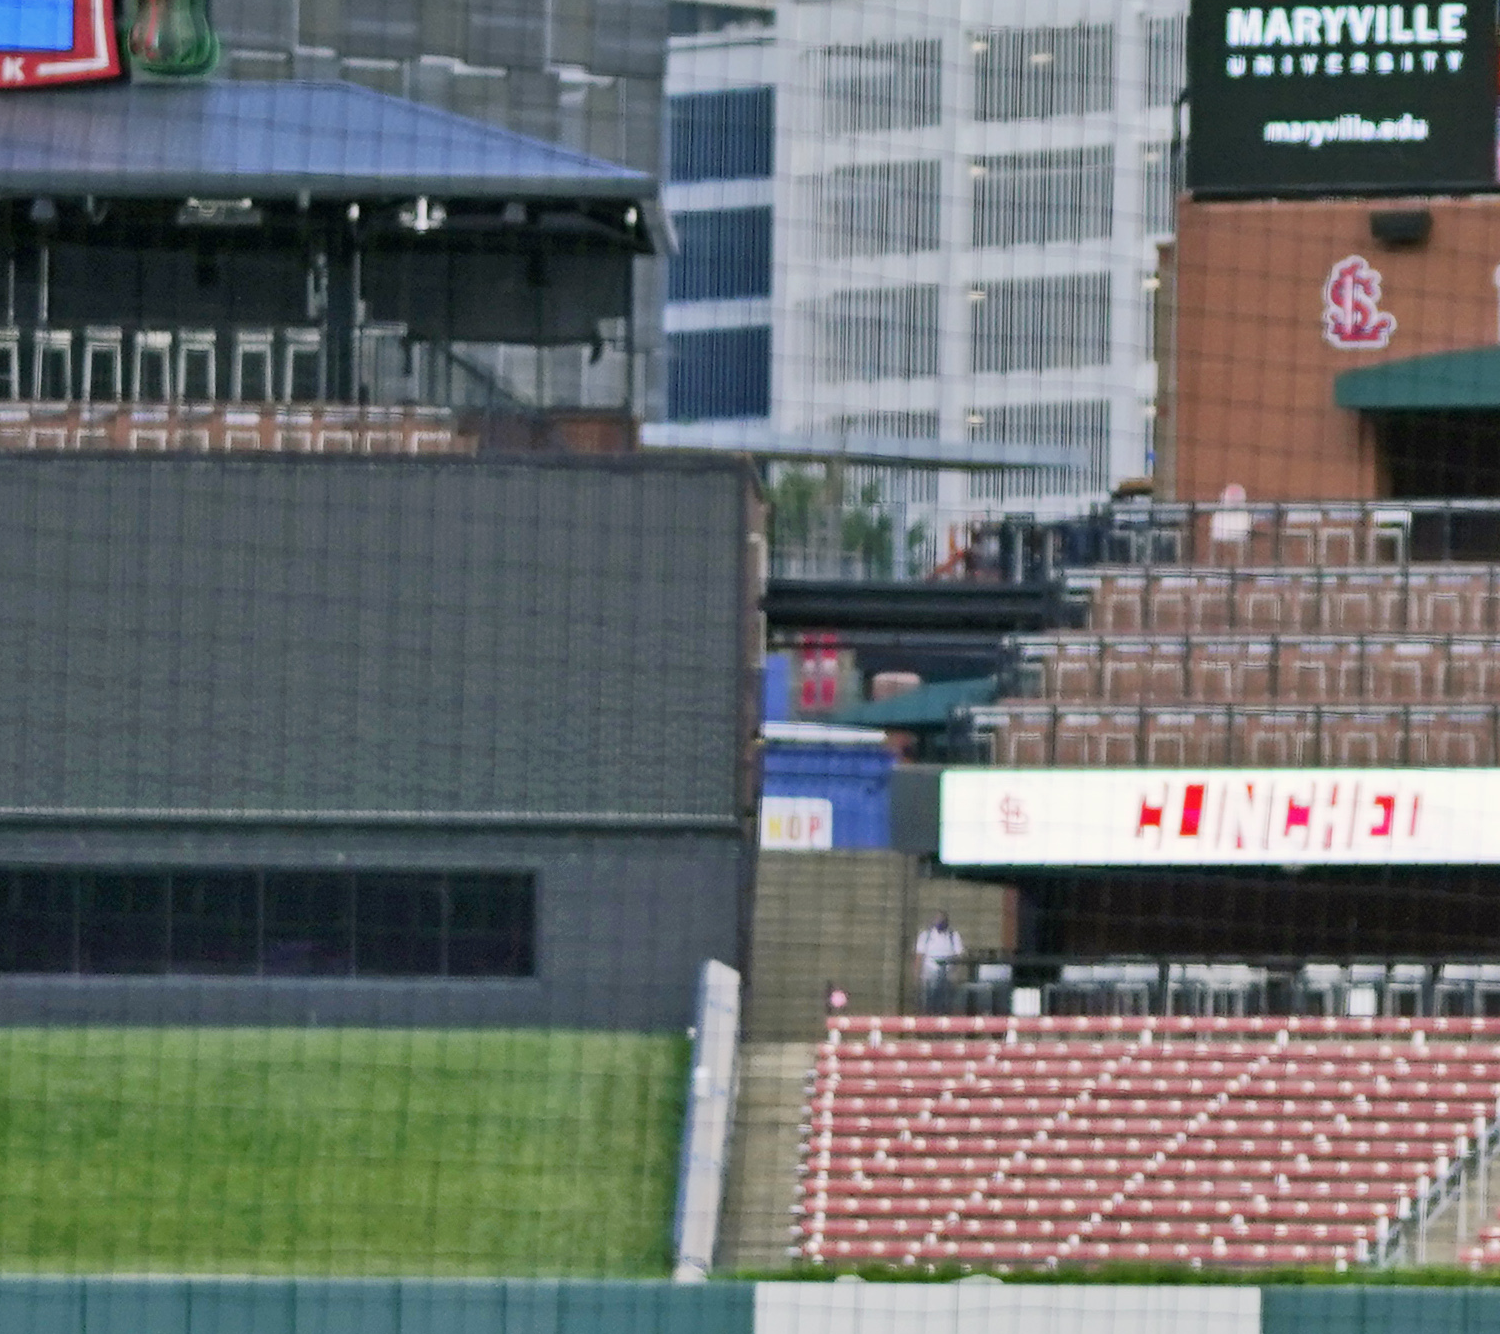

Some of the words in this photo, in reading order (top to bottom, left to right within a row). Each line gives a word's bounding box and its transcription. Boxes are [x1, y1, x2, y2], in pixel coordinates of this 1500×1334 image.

[1226, 3, 1466, 47] MARYVILLE
[1226, 50, 1465, 77] UNIVERSITY
[1264, 115, 1430, 146] maryville.edu
